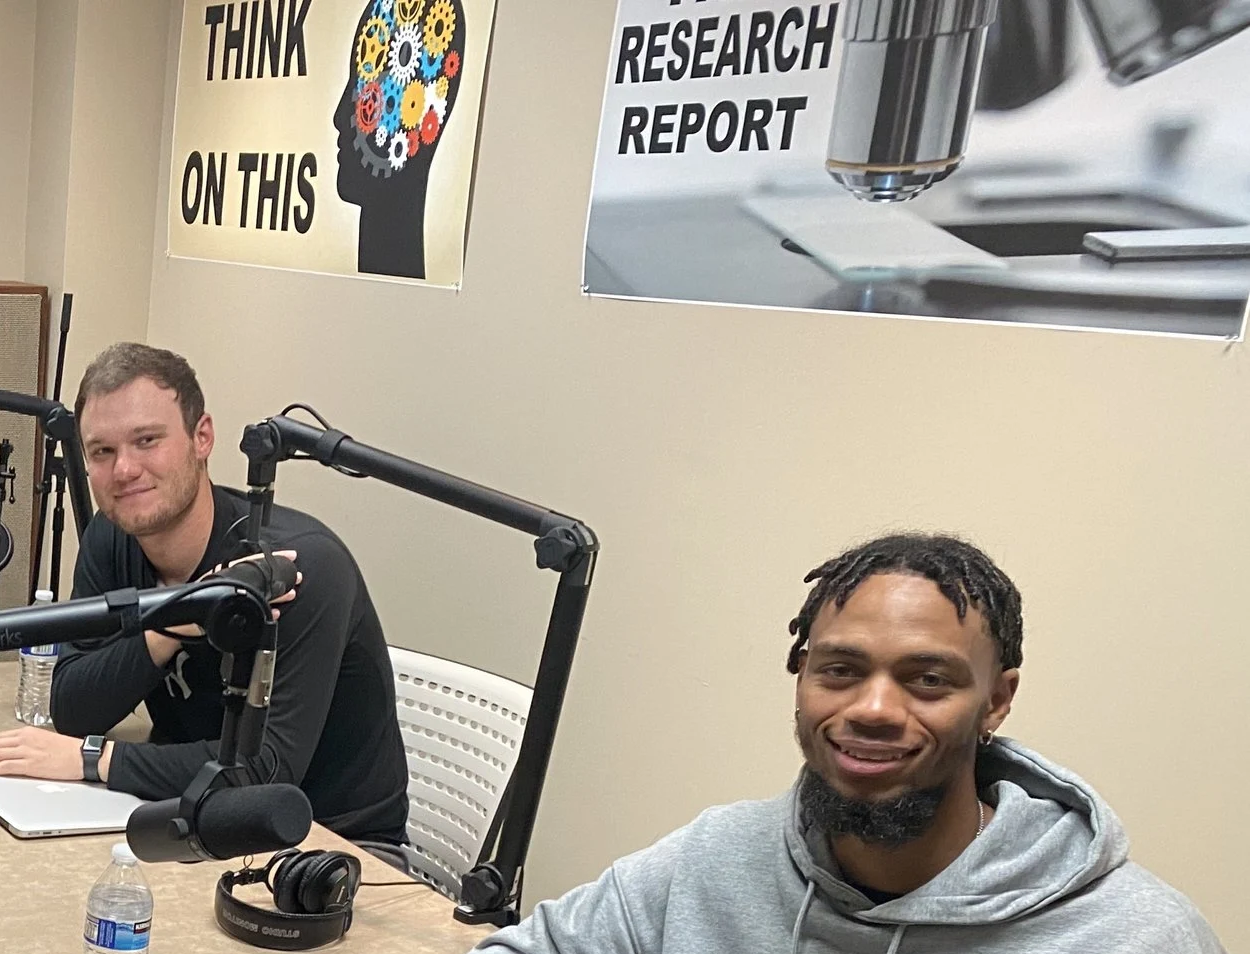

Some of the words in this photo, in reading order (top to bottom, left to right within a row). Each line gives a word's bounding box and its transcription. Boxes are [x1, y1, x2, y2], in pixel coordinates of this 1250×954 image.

[204, 0, 312, 81] THINK
[614, 3, 839, 84] RESEARCH
[618, 97, 808, 155] REPORT
[181, 150, 228, 226] ON
[237, 152, 318, 235] THIS
